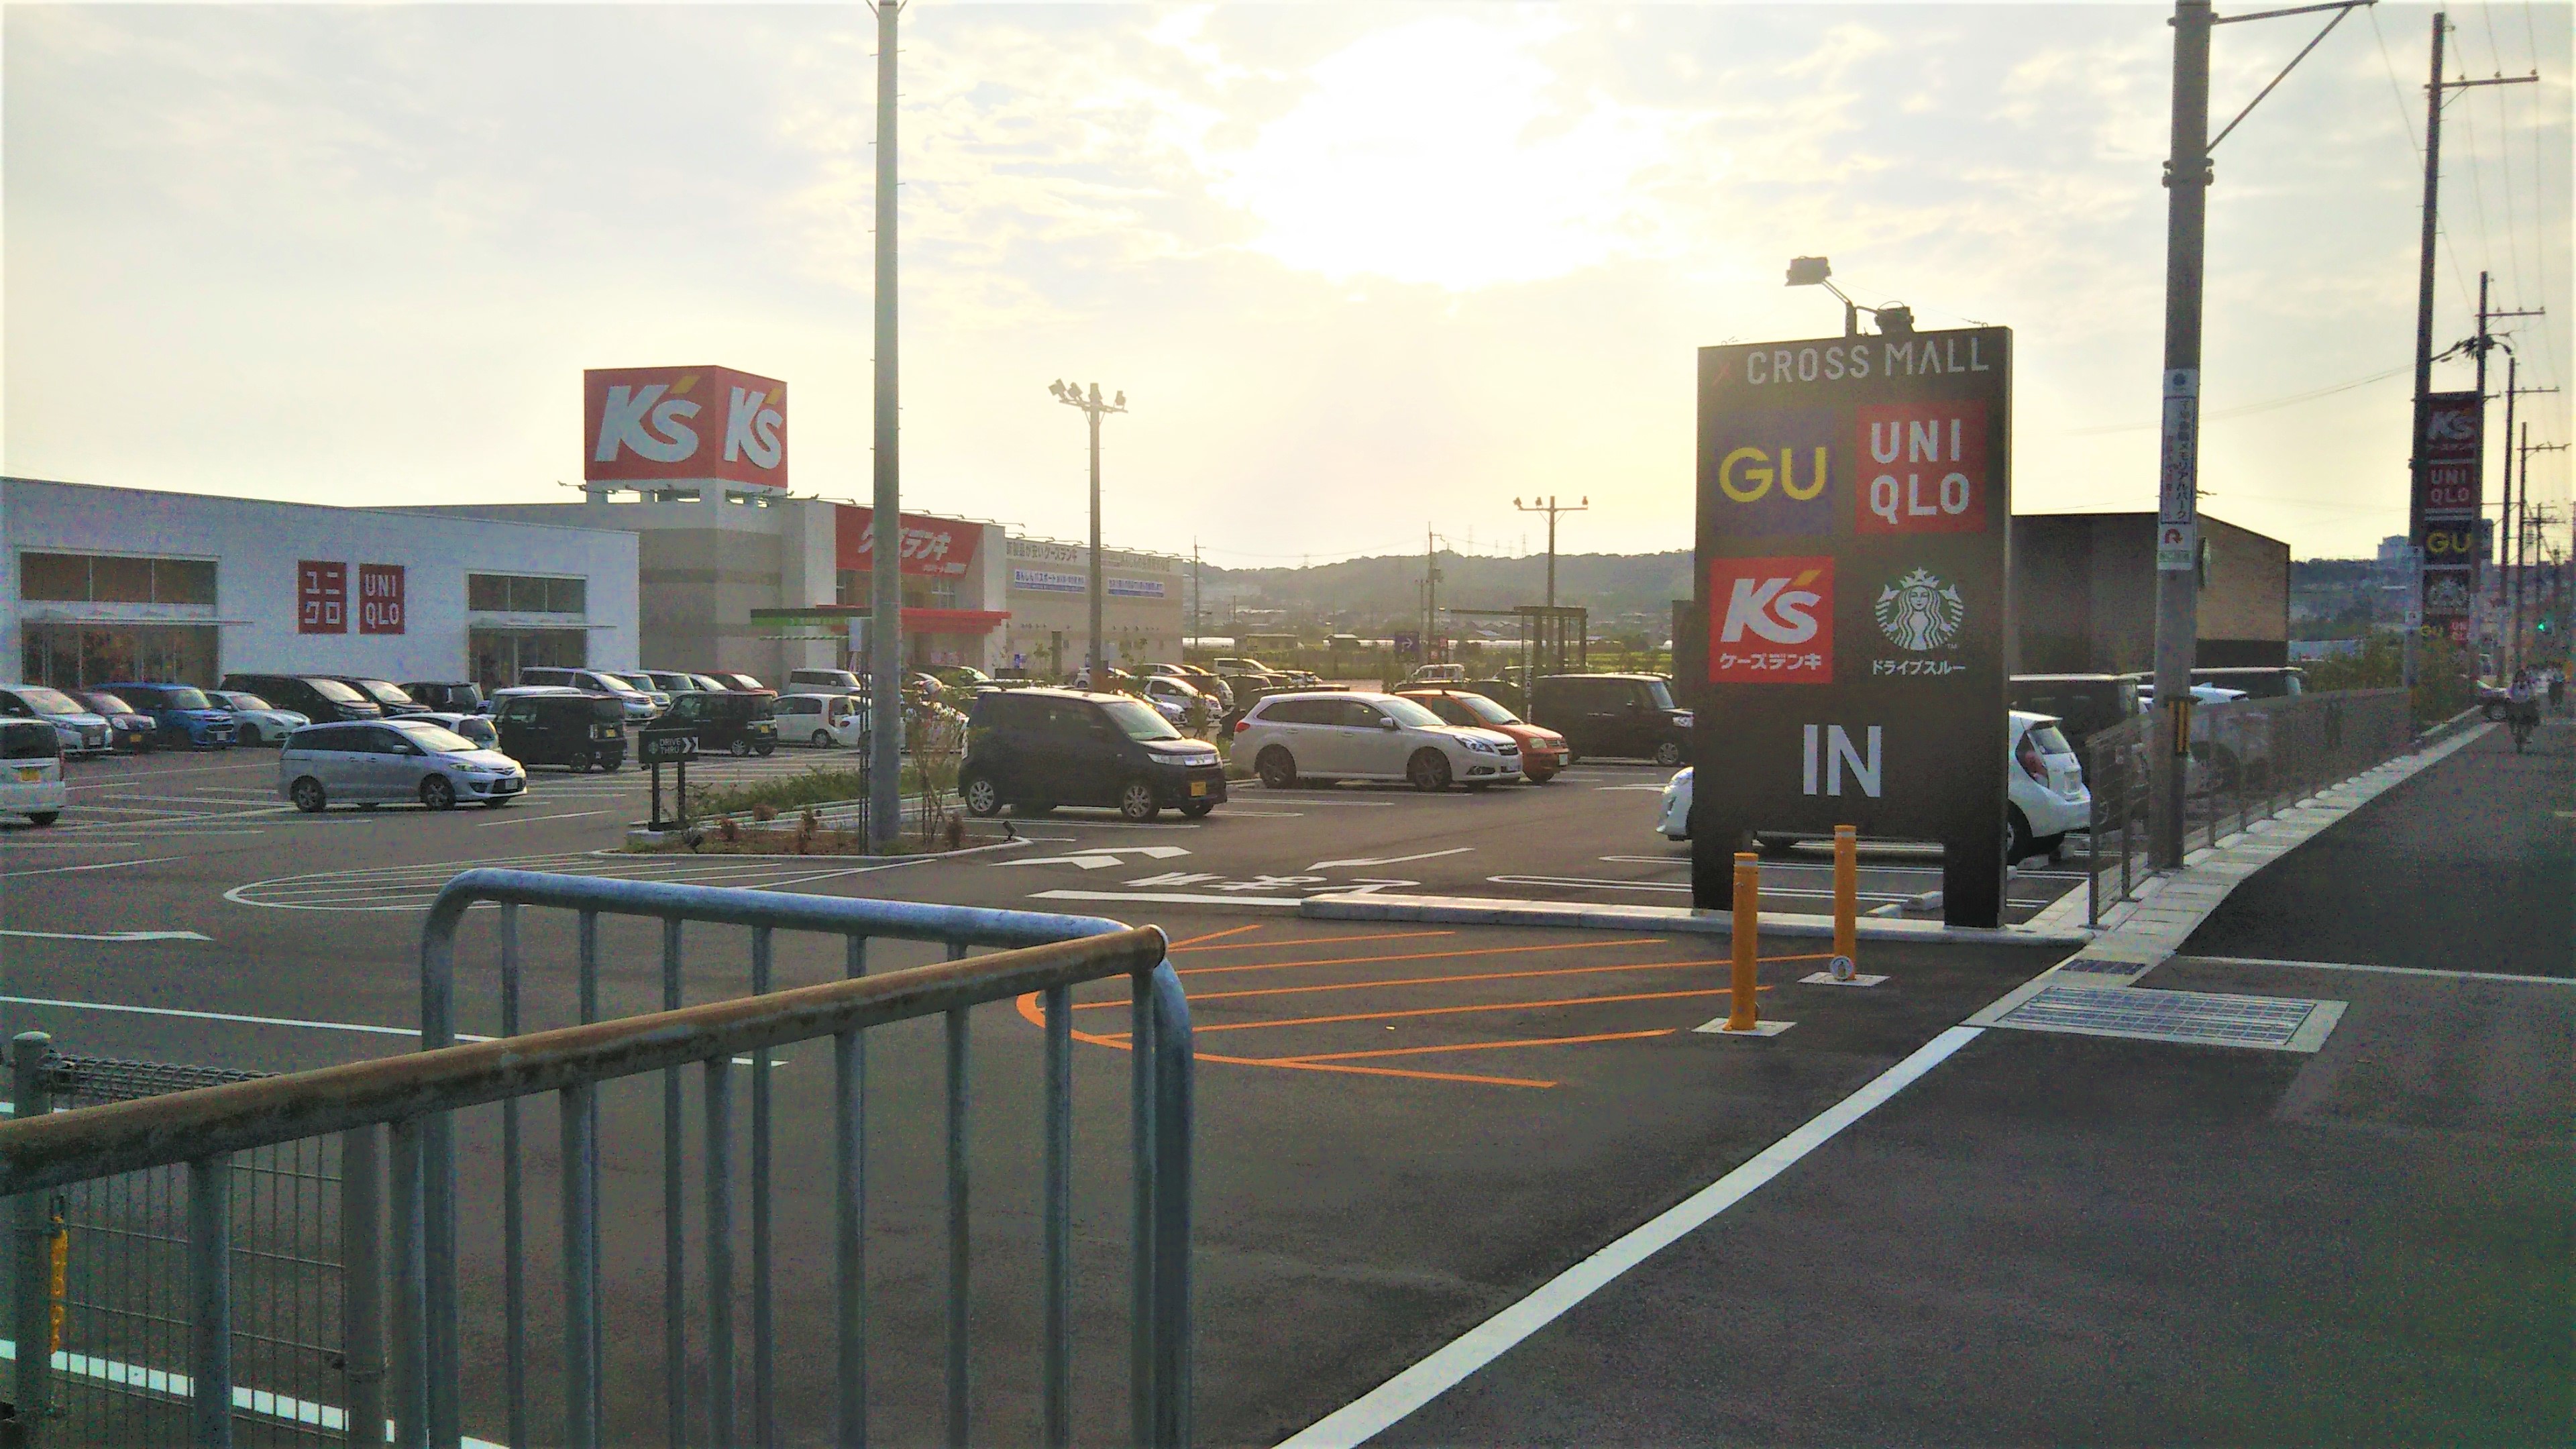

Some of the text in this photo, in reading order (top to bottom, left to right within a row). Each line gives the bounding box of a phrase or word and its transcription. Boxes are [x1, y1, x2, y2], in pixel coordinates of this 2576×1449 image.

[1747, 337, 1990, 385] CROSS MALL
[1870, 419, 1961, 464] UNI
[1719, 447, 1827, 502] GU
[2430, 469, 2467, 485] UNI
[1870, 472, 1970, 525] QLO
[2430, 487, 2470, 505] QLO
[2426, 532, 2471, 554] GU
[364, 574, 396, 597] UNI
[365, 602, 400, 629] QLO
[1720, 569, 1822, 645] K's
[1719, 652, 1822, 672] ケーズデンキ
[1872, 659, 1966, 676] ドライブスルー
[659, 738, 681, 747] DRIVE
[659, 745, 680, 754] THRU
[1803, 724, 1882, 798] IN
